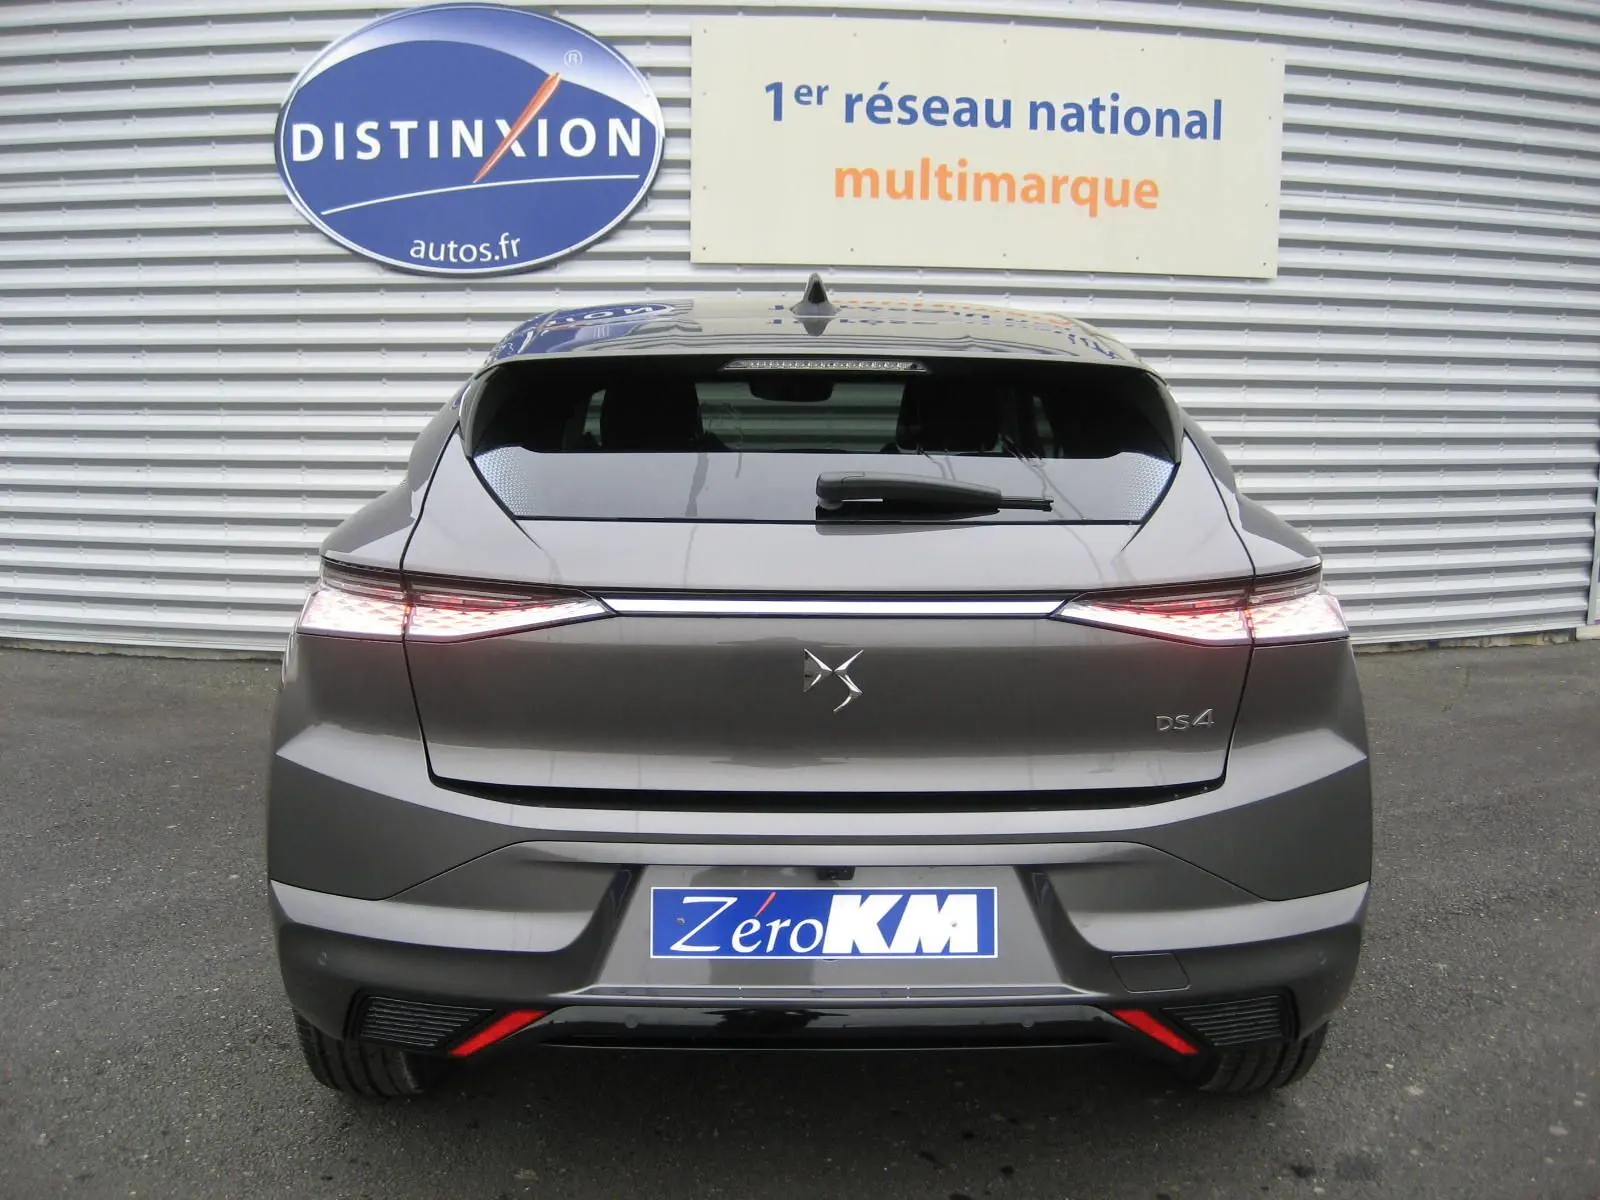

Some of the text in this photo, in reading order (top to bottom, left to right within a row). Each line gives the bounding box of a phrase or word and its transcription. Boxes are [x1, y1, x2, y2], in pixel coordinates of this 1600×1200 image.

[844, 81, 1012, 130] réseau
[1028, 92, 1223, 142] national
[834, 157, 1160, 218] multimarque
[409, 232, 522, 264] autos.fr
